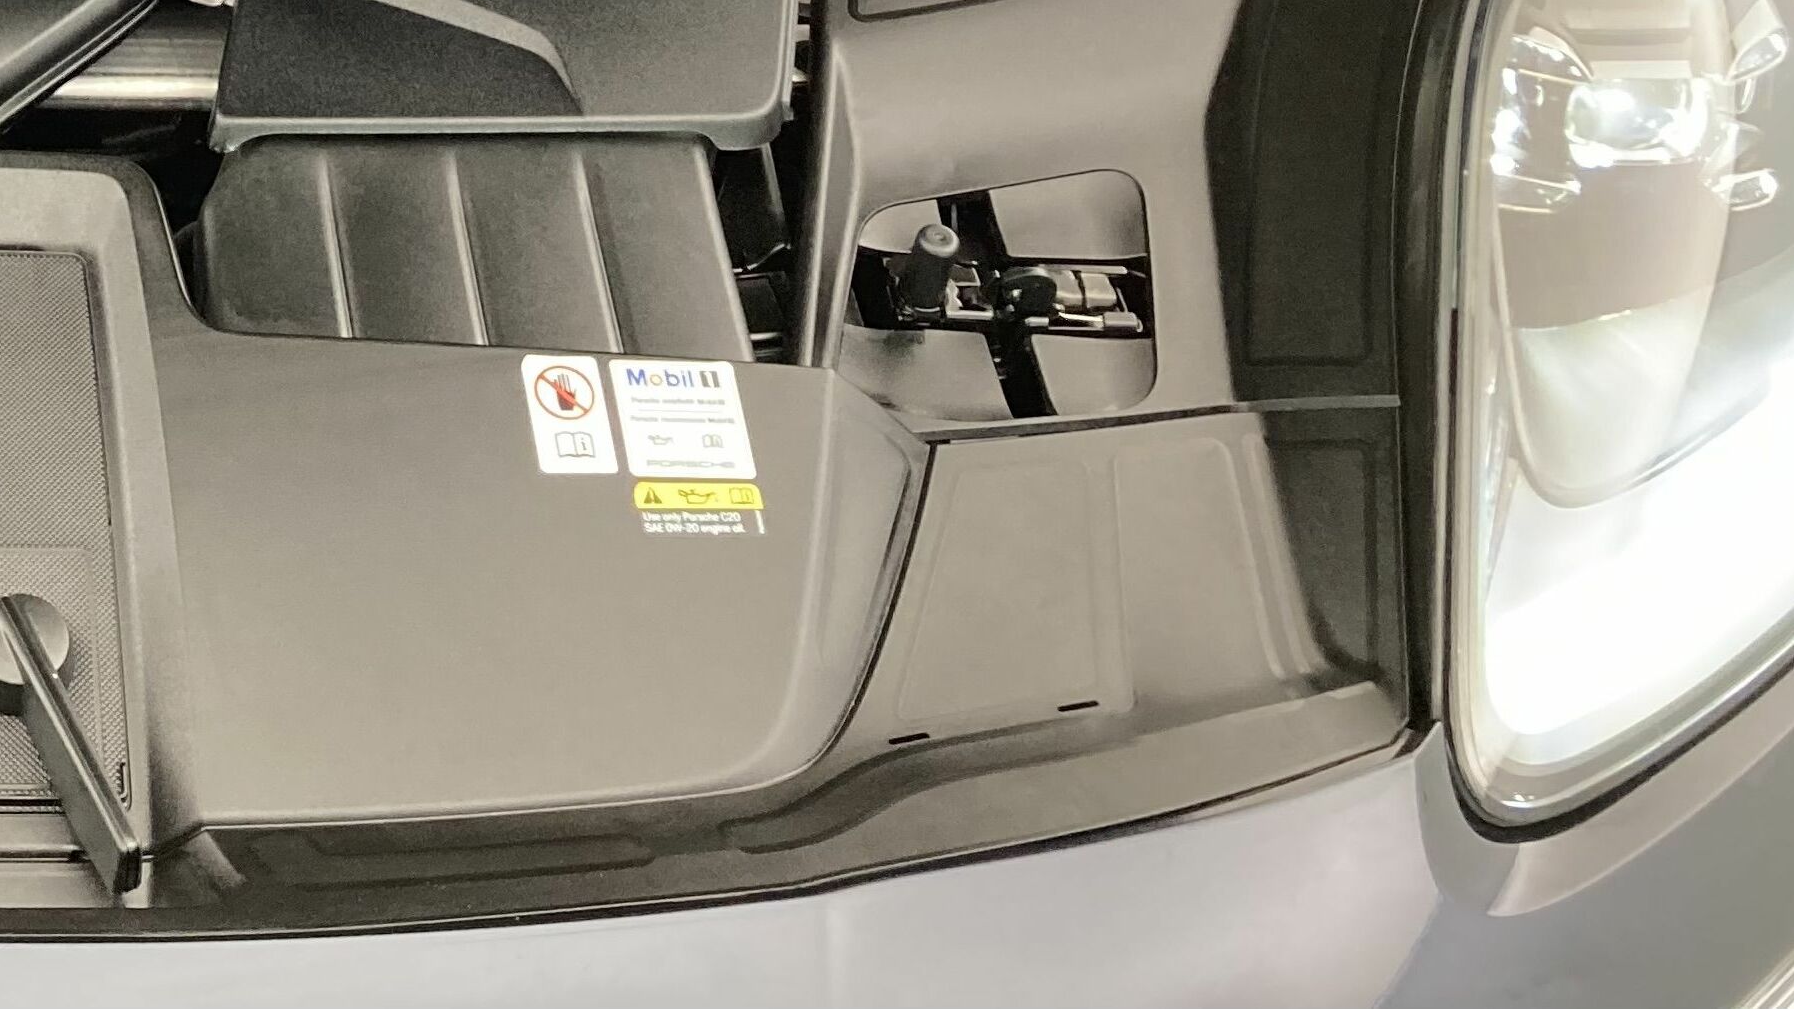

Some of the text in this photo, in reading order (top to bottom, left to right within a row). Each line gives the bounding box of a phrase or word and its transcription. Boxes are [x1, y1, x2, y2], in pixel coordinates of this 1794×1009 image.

[625, 368, 696, 389] Mobil
[641, 511, 742, 524] Use only Porsche C20
[643, 522, 665, 533] SAE
[700, 524, 732, 536] engine
